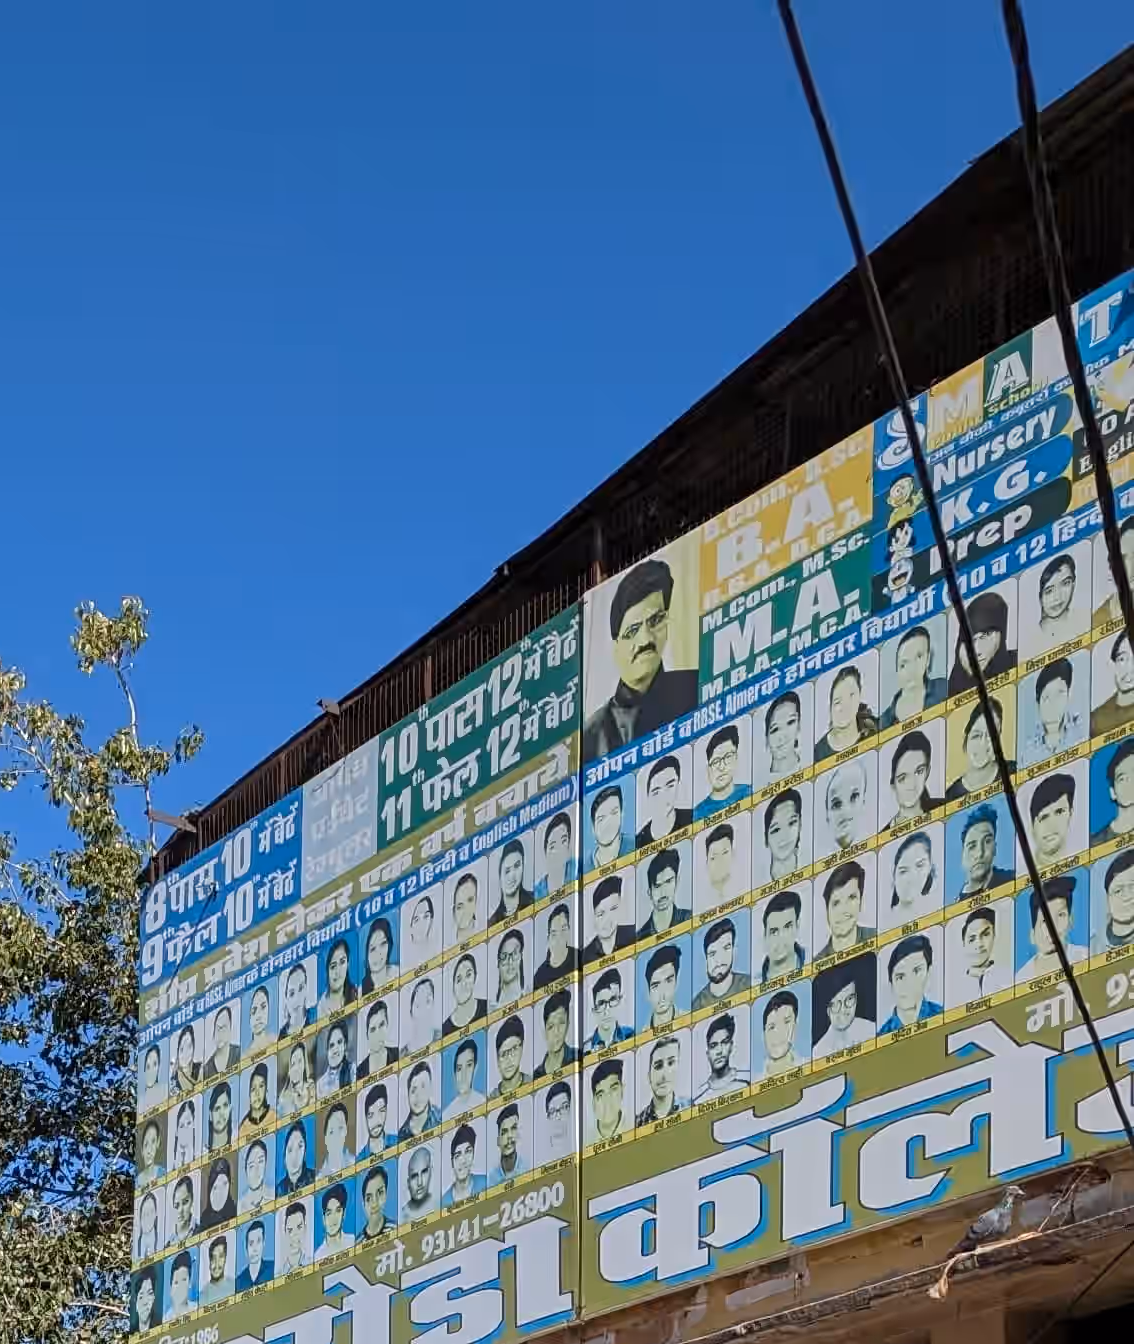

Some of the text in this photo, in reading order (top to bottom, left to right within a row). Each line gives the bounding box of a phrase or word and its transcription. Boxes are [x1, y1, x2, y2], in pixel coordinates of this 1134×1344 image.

[933, 405, 1057, 492] Nursery
[585, 746, 637, 787] ओपन
[1016, 533, 1047, 565] 12
[713, 568, 859, 676] M.A.
[425, 680, 489, 754] पास
[422, 748, 482, 813] फेल
[472, 814, 518, 850] English
[420, 1180, 566, 1265] 93141-26800
